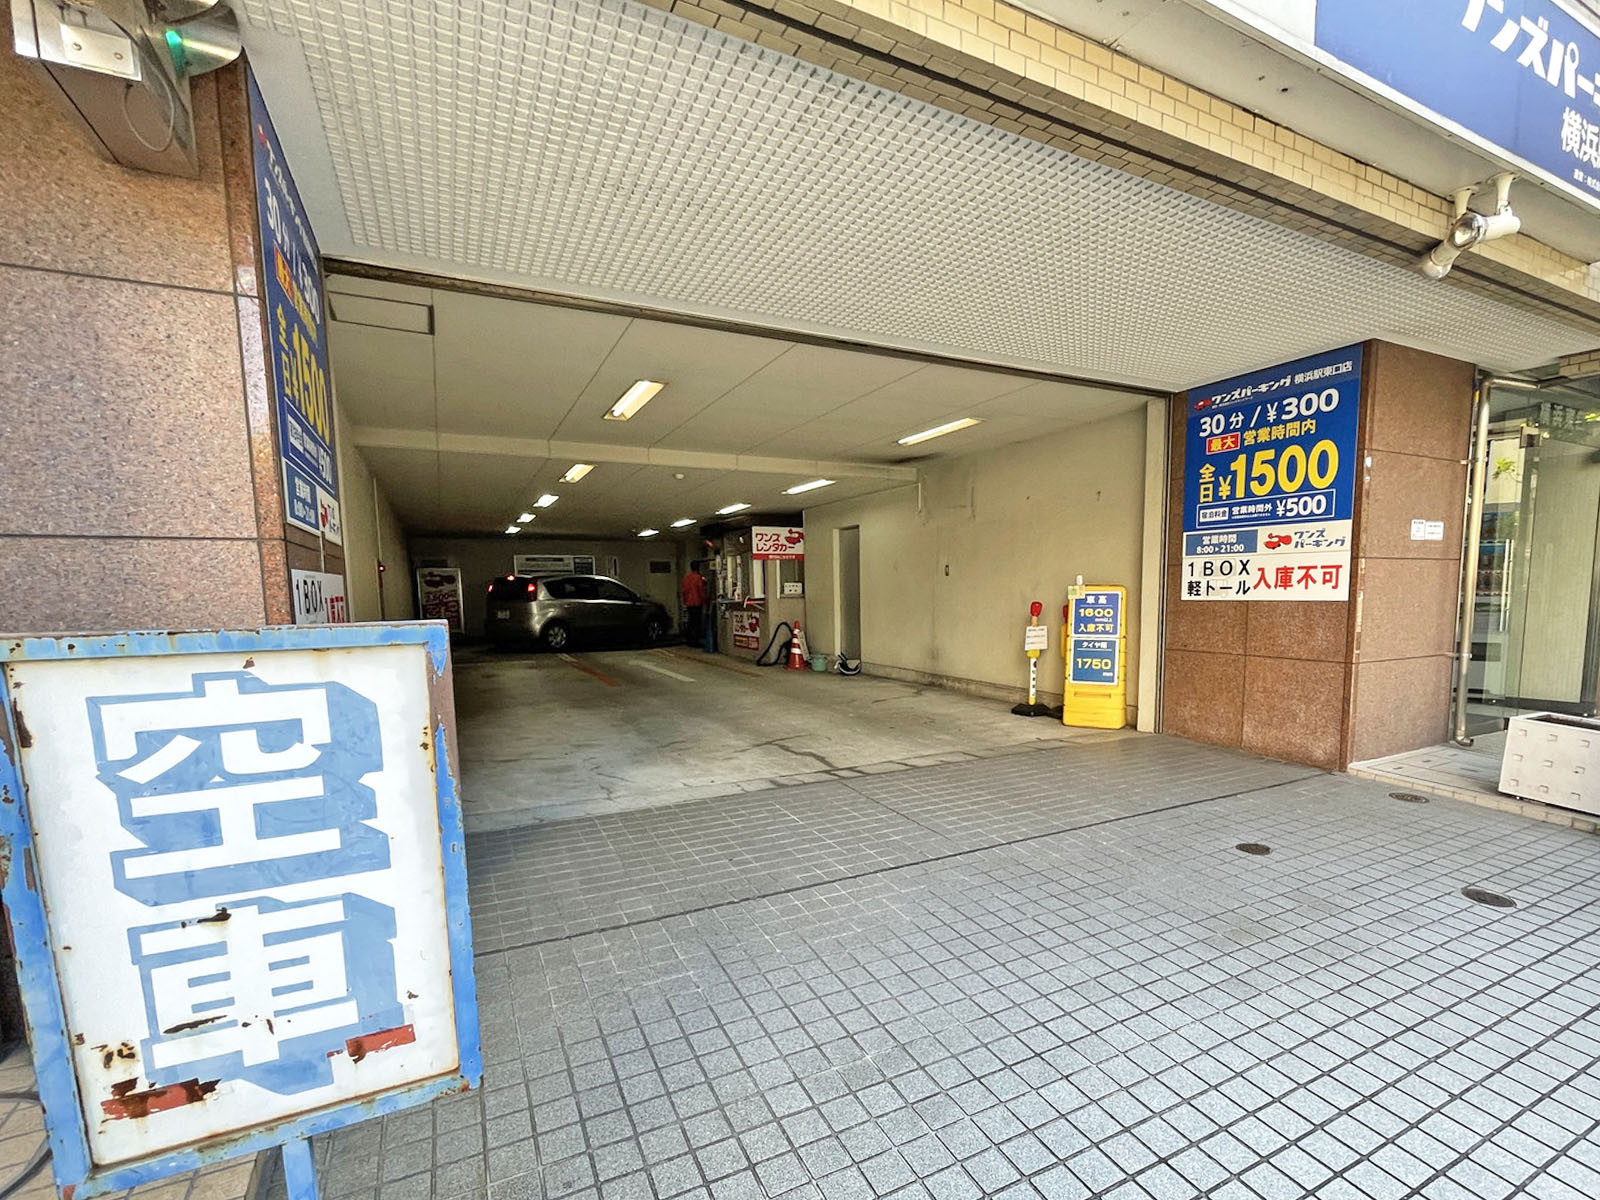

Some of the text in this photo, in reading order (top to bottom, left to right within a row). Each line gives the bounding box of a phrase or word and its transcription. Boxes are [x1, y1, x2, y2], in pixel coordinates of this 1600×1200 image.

[1461, 0, 1600, 108] ンズパー
[1561, 106, 1600, 169] 横浜
[1294, 361, 1353, 385] 横浜駅東口店
[1210, 419, 1317, 452] 最大 営業時間内
[1218, 439, 1340, 500] ¥1500
[1276, 494, 1327, 518] ¥500
[1294, 527, 1326, 539] ワンズ
[1294, 537, 1346, 549] パーキング
[756, 543, 796, 552] レンタカー
[1187, 579, 1251, 597] 軽トール
[1253, 564, 1343, 591] 入庫不可
[1079, 608, 1114, 618] 1600
[1077, 658, 1112, 669] 1750
[93, 674, 375, 1082] 空車
